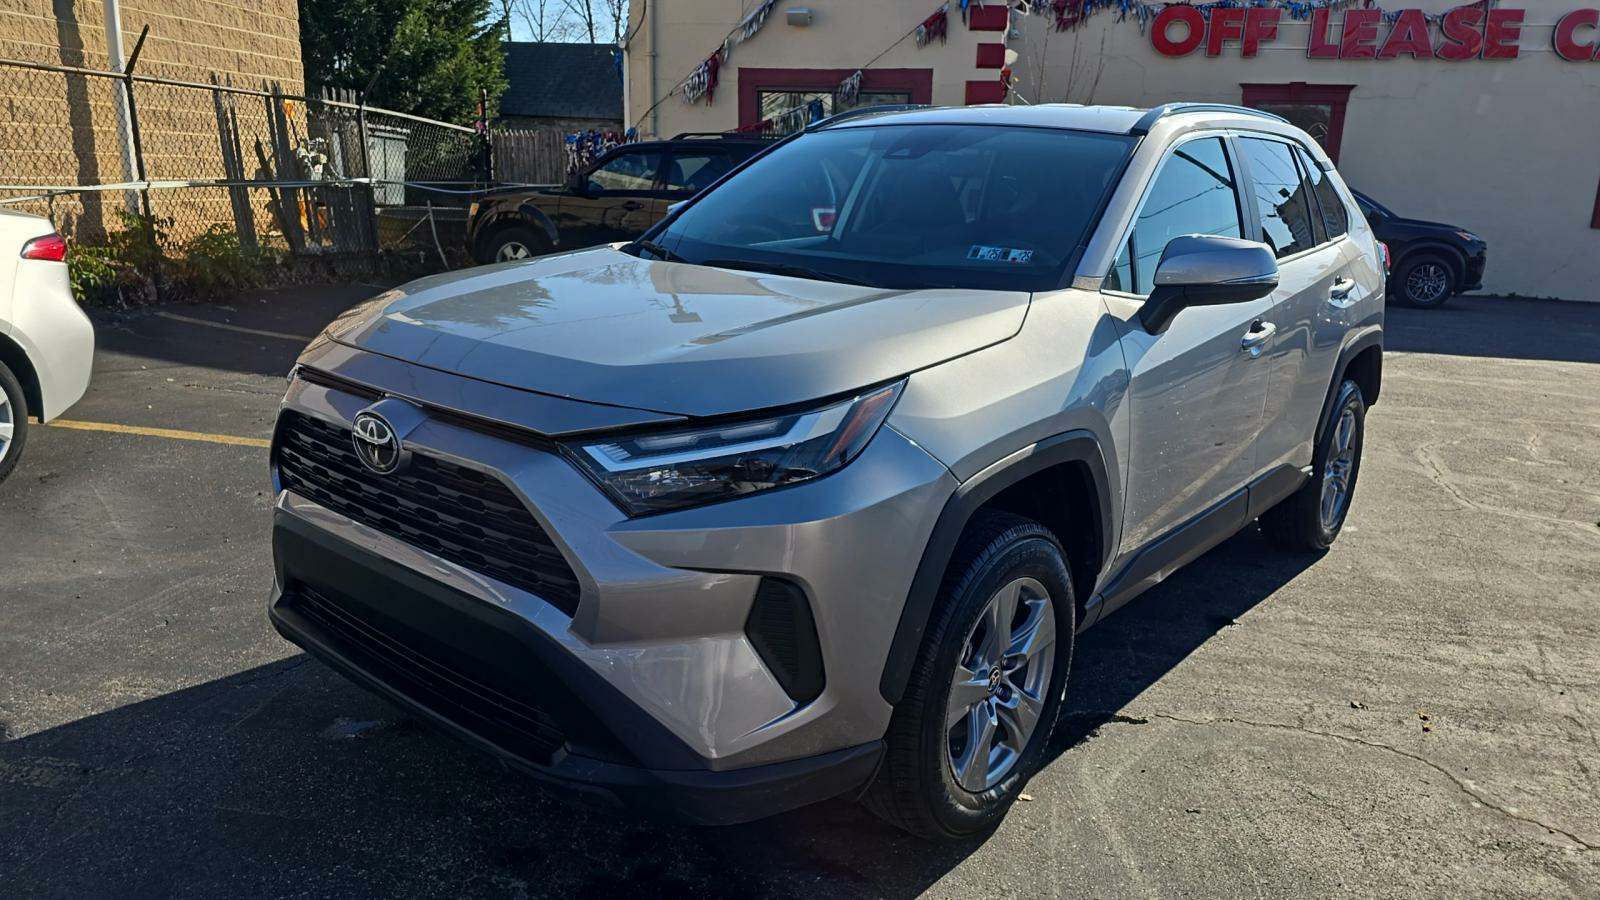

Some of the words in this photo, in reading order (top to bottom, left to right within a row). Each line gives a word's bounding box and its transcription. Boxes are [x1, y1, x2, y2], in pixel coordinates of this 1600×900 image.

[1151, 6, 1281, 58] OFF
[1307, 7, 1526, 60] LEASE
[1552, 8, 1600, 62] C
